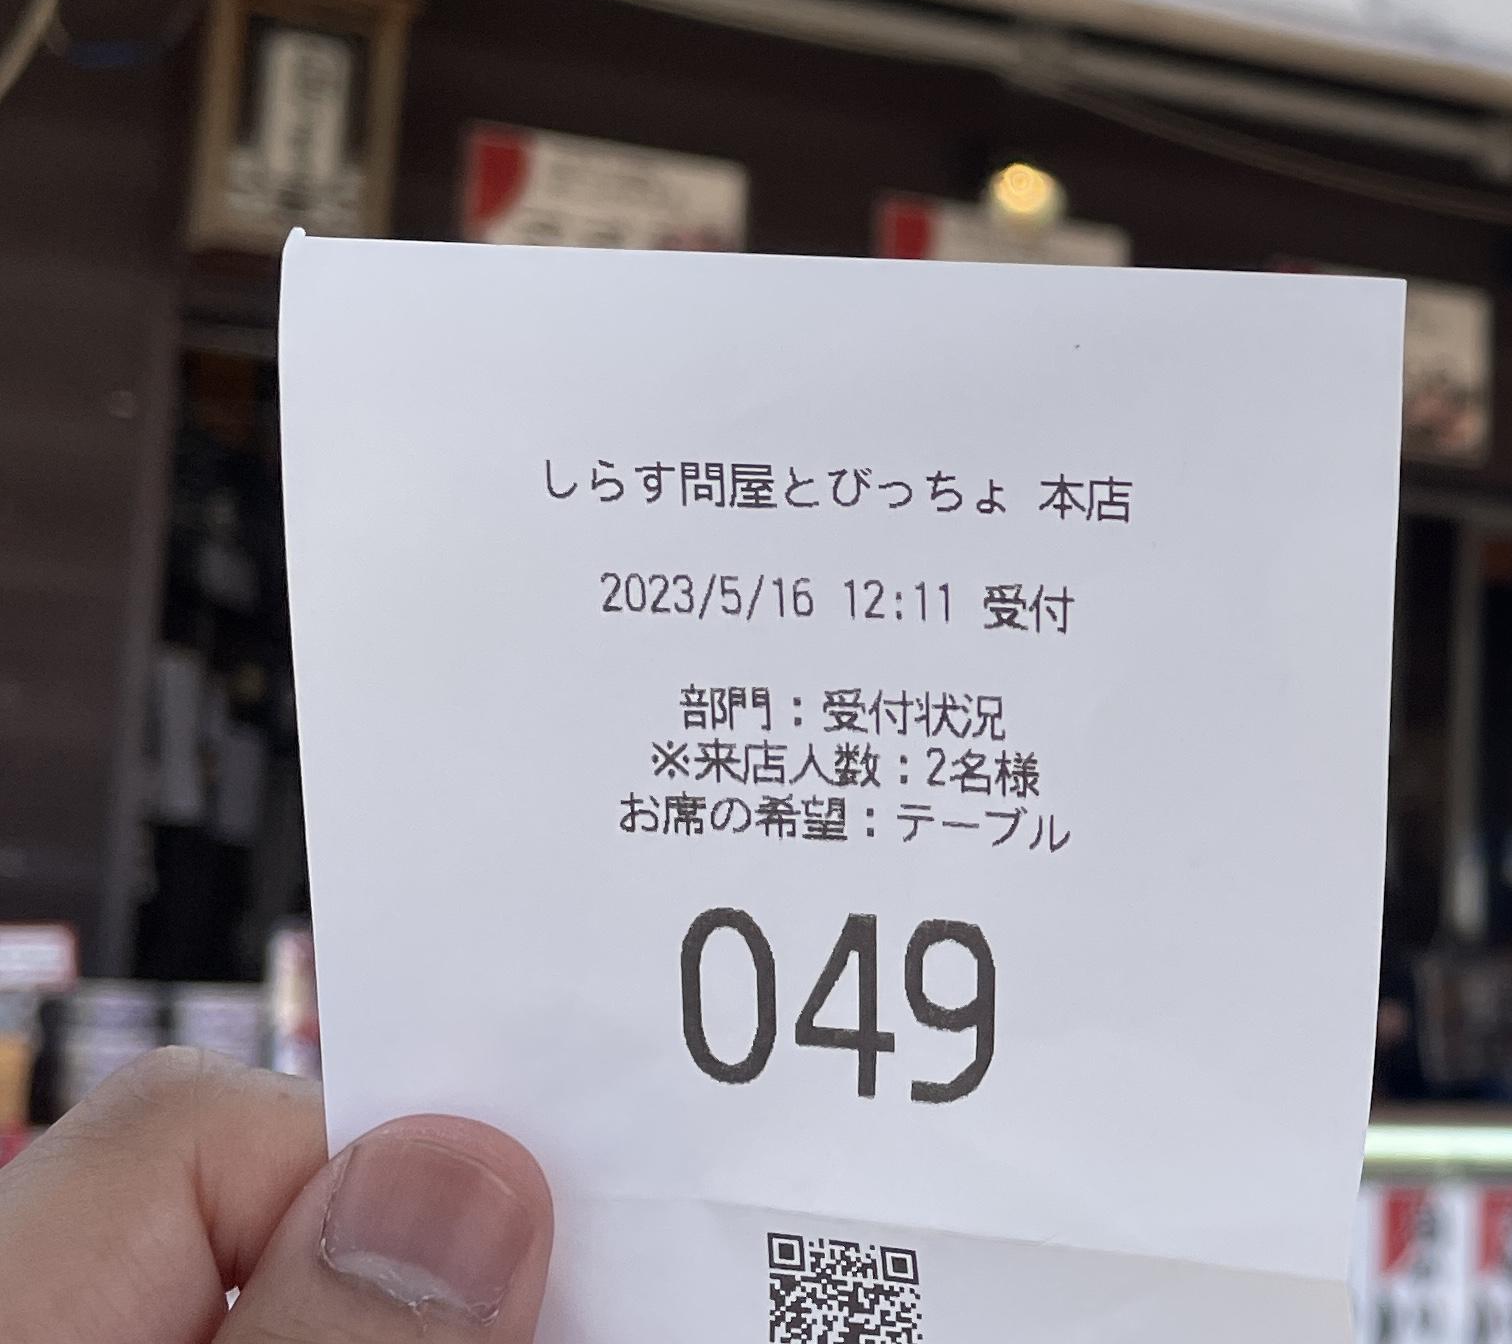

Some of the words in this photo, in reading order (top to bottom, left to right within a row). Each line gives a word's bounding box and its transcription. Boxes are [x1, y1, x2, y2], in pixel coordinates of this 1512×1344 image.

[542, 458, 1008, 515] しらす問屋とびっちょ
[1038, 472, 1133, 524] 本店
[599, 571, 814, 621] 2023/5/16
[842, 577, 951, 623] 12:11
[982, 583, 1076, 635] 受付
[679, 905, 996, 1105] 049
